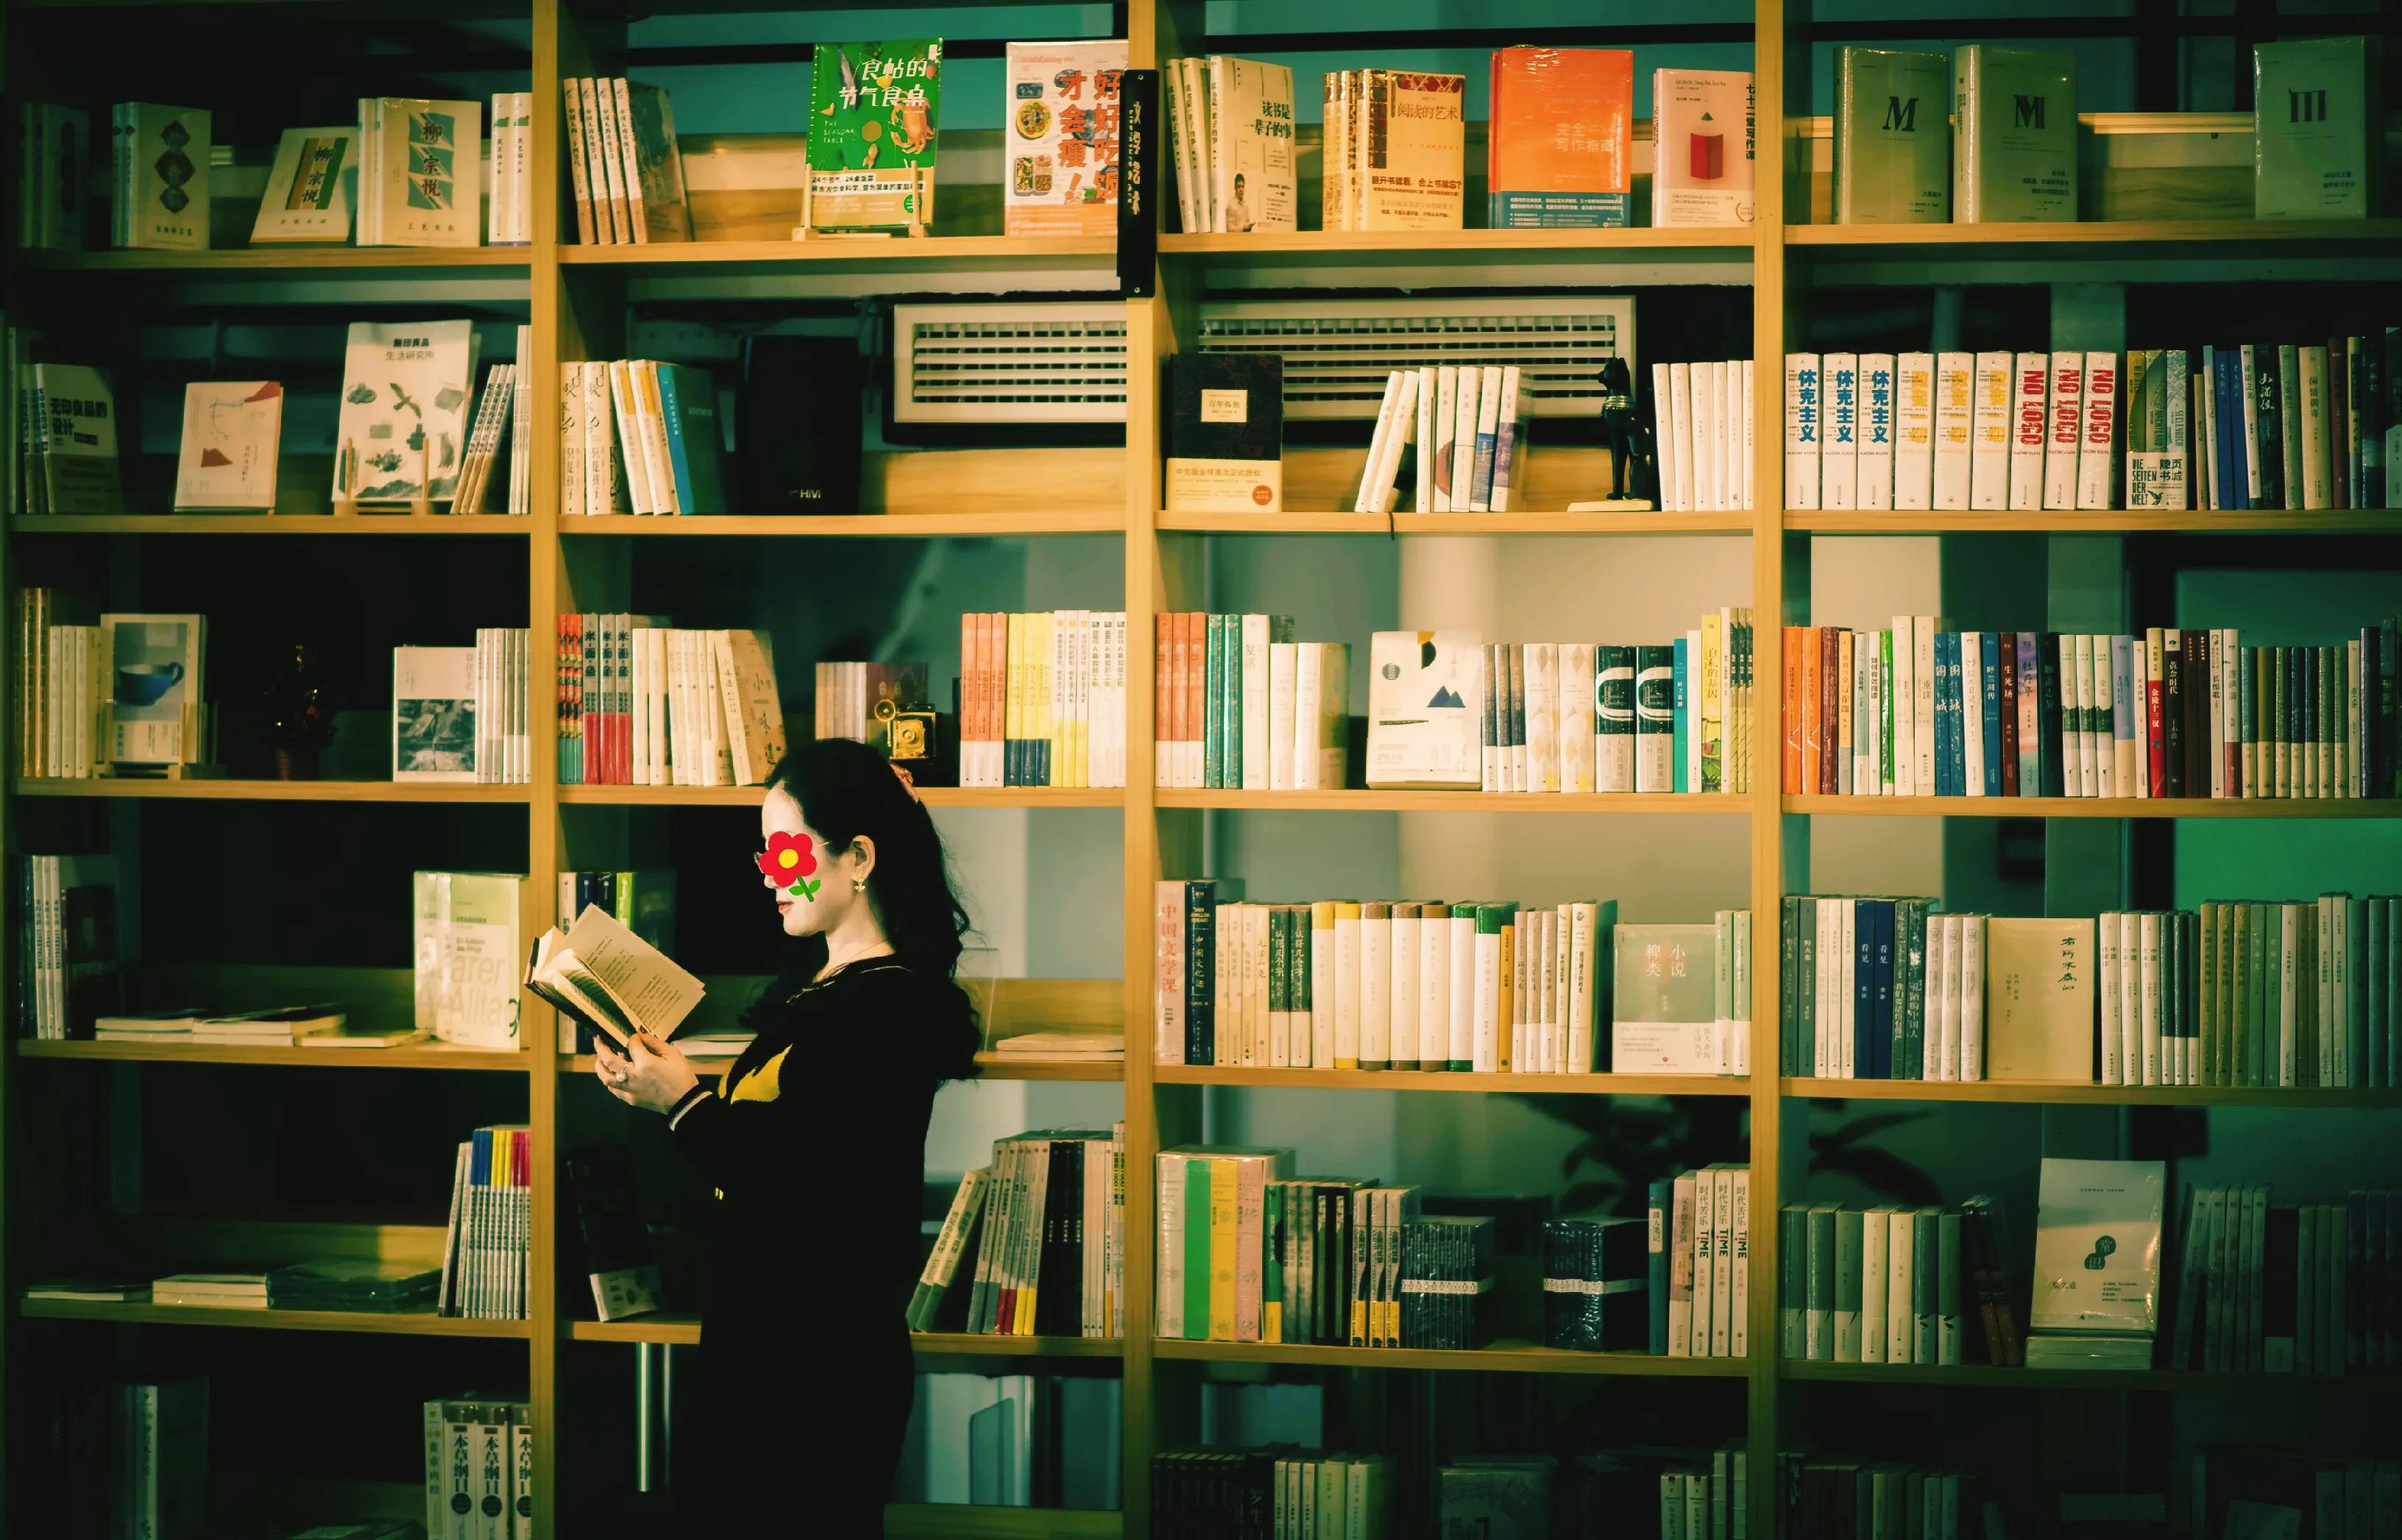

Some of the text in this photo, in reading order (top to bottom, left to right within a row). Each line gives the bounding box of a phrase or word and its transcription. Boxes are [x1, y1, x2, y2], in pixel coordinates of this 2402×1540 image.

[861, 57, 928, 81] 食帖的
[838, 83, 927, 110] 节气食桌
[1262, 100, 1291, 120] 读书是
[1397, 103, 1459, 120] 阅读的艺术
[1882, 96, 1920, 132] M
[2013, 94, 2046, 129] M
[1094, 69, 1121, 202] 好好吃饭
[301, 146, 333, 203] 柳宗悦
[422, 121, 443, 197] 柳宗悦
[385, 350, 434, 361] 生活研究所
[1798, 369, 1817, 442] 休克主义
[1836, 369, 1854, 443] 休克主义
[1871, 370, 1890, 443] 休克主义
[2020, 370, 2045, 445] NO LOGO
[2055, 369, 2080, 443] NO LOGO
[2088, 369, 2114, 444] NO LOGO
[2132, 459, 2144, 469] DIE
[2132, 470, 2157, 481] SEITEN
[800, 489, 821, 500] HiVi
[2131, 494, 2148, 505] WELT
[2132, 482, 2146, 493] DER
[1708, 647, 1718, 700] 自私的基因
[1986, 665, 1996, 700] 呼兰河传
[2004, 665, 2013, 700] 生死场
[2023, 662, 2033, 698] 牡丹亭
[2169, 661, 2178, 695] 黄金时代
[2212, 675, 2220, 699] 长恨歌
[2151, 688, 2160, 728] 金陵十三钗
[1161, 904, 1178, 993] 中国文学课
[1275, 929, 1285, 976] 认得几个字
[1294, 929, 1304, 976] 认得几个字
[1645, 943, 1661, 978] 稗类
[1669, 943, 1686, 978] 小说
[1803, 939, 1812, 962] 野火集
[1861, 943, 1869, 963] 看见
[1880, 945, 1888, 965] 看见
[2130, 947, 2137, 961] 中国
[2150, 948, 2157, 962] 中国
[1698, 1185, 1709, 1226] 时代苦乐
[1718, 1183, 1728, 1225] 时代苦乐
[1736, 1185, 1747, 1227] 时代苦乐
